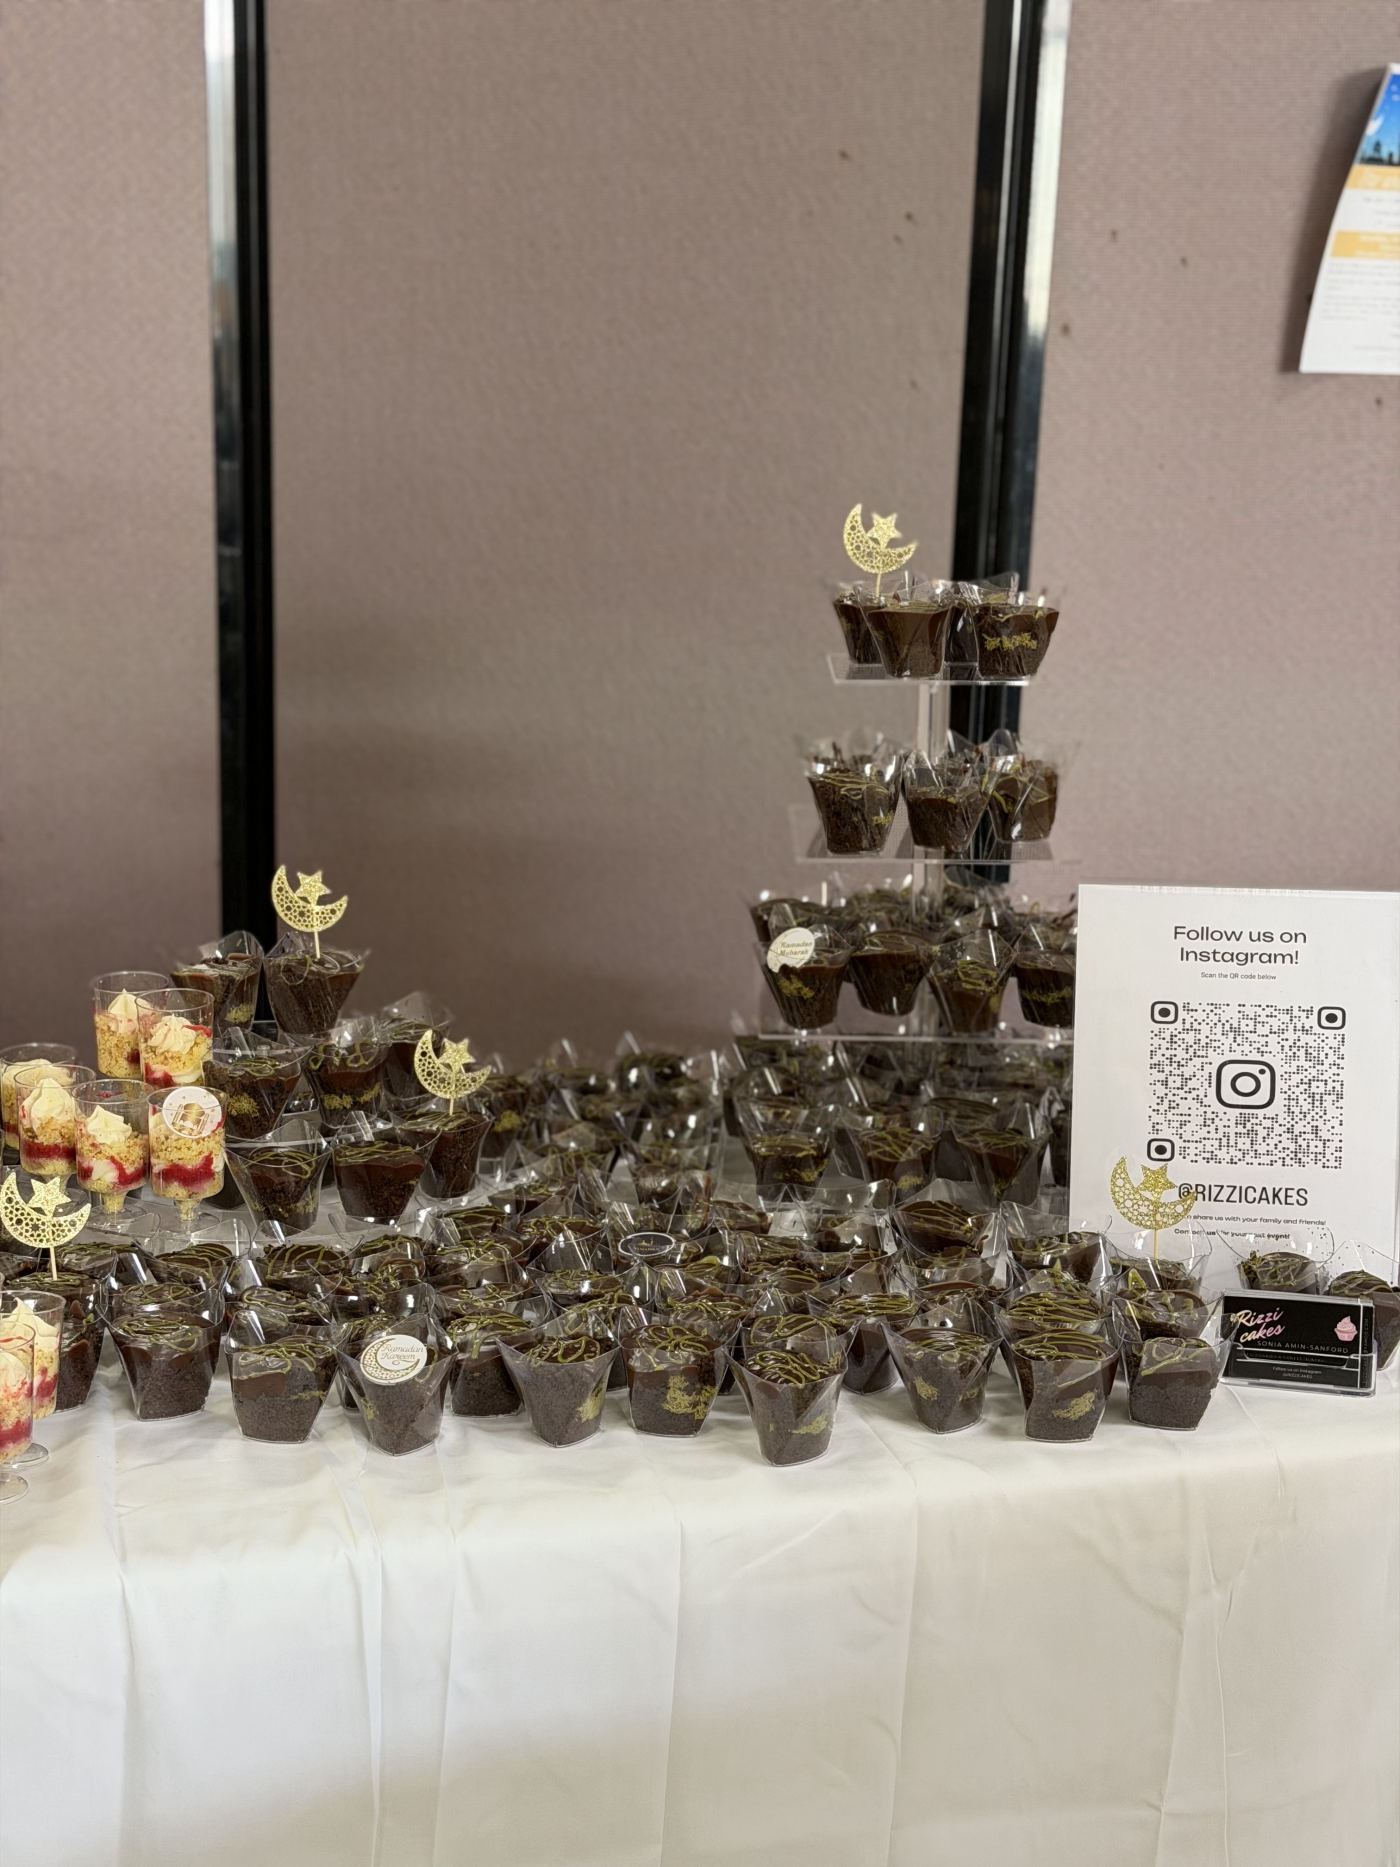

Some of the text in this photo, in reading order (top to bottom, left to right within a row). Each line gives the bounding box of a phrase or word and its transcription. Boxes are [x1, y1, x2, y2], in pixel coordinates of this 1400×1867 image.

[1174, 926, 1307, 944] Follow us on
[1180, 947, 1299, 966] Instagram!
[1178, 1183, 1308, 1206] @RIZZICAKES
[1259, 1217, 1282, 1225] family
[1237, 1307, 1284, 1327] Rizzi
[1240, 1323, 1285, 1342] cakes
[381, 1344, 424, 1353] Ramadan
[1257, 1340, 1349, 1354] SONIA AMIN-SANFORD
[380, 1352, 417, 1361] Kareem
